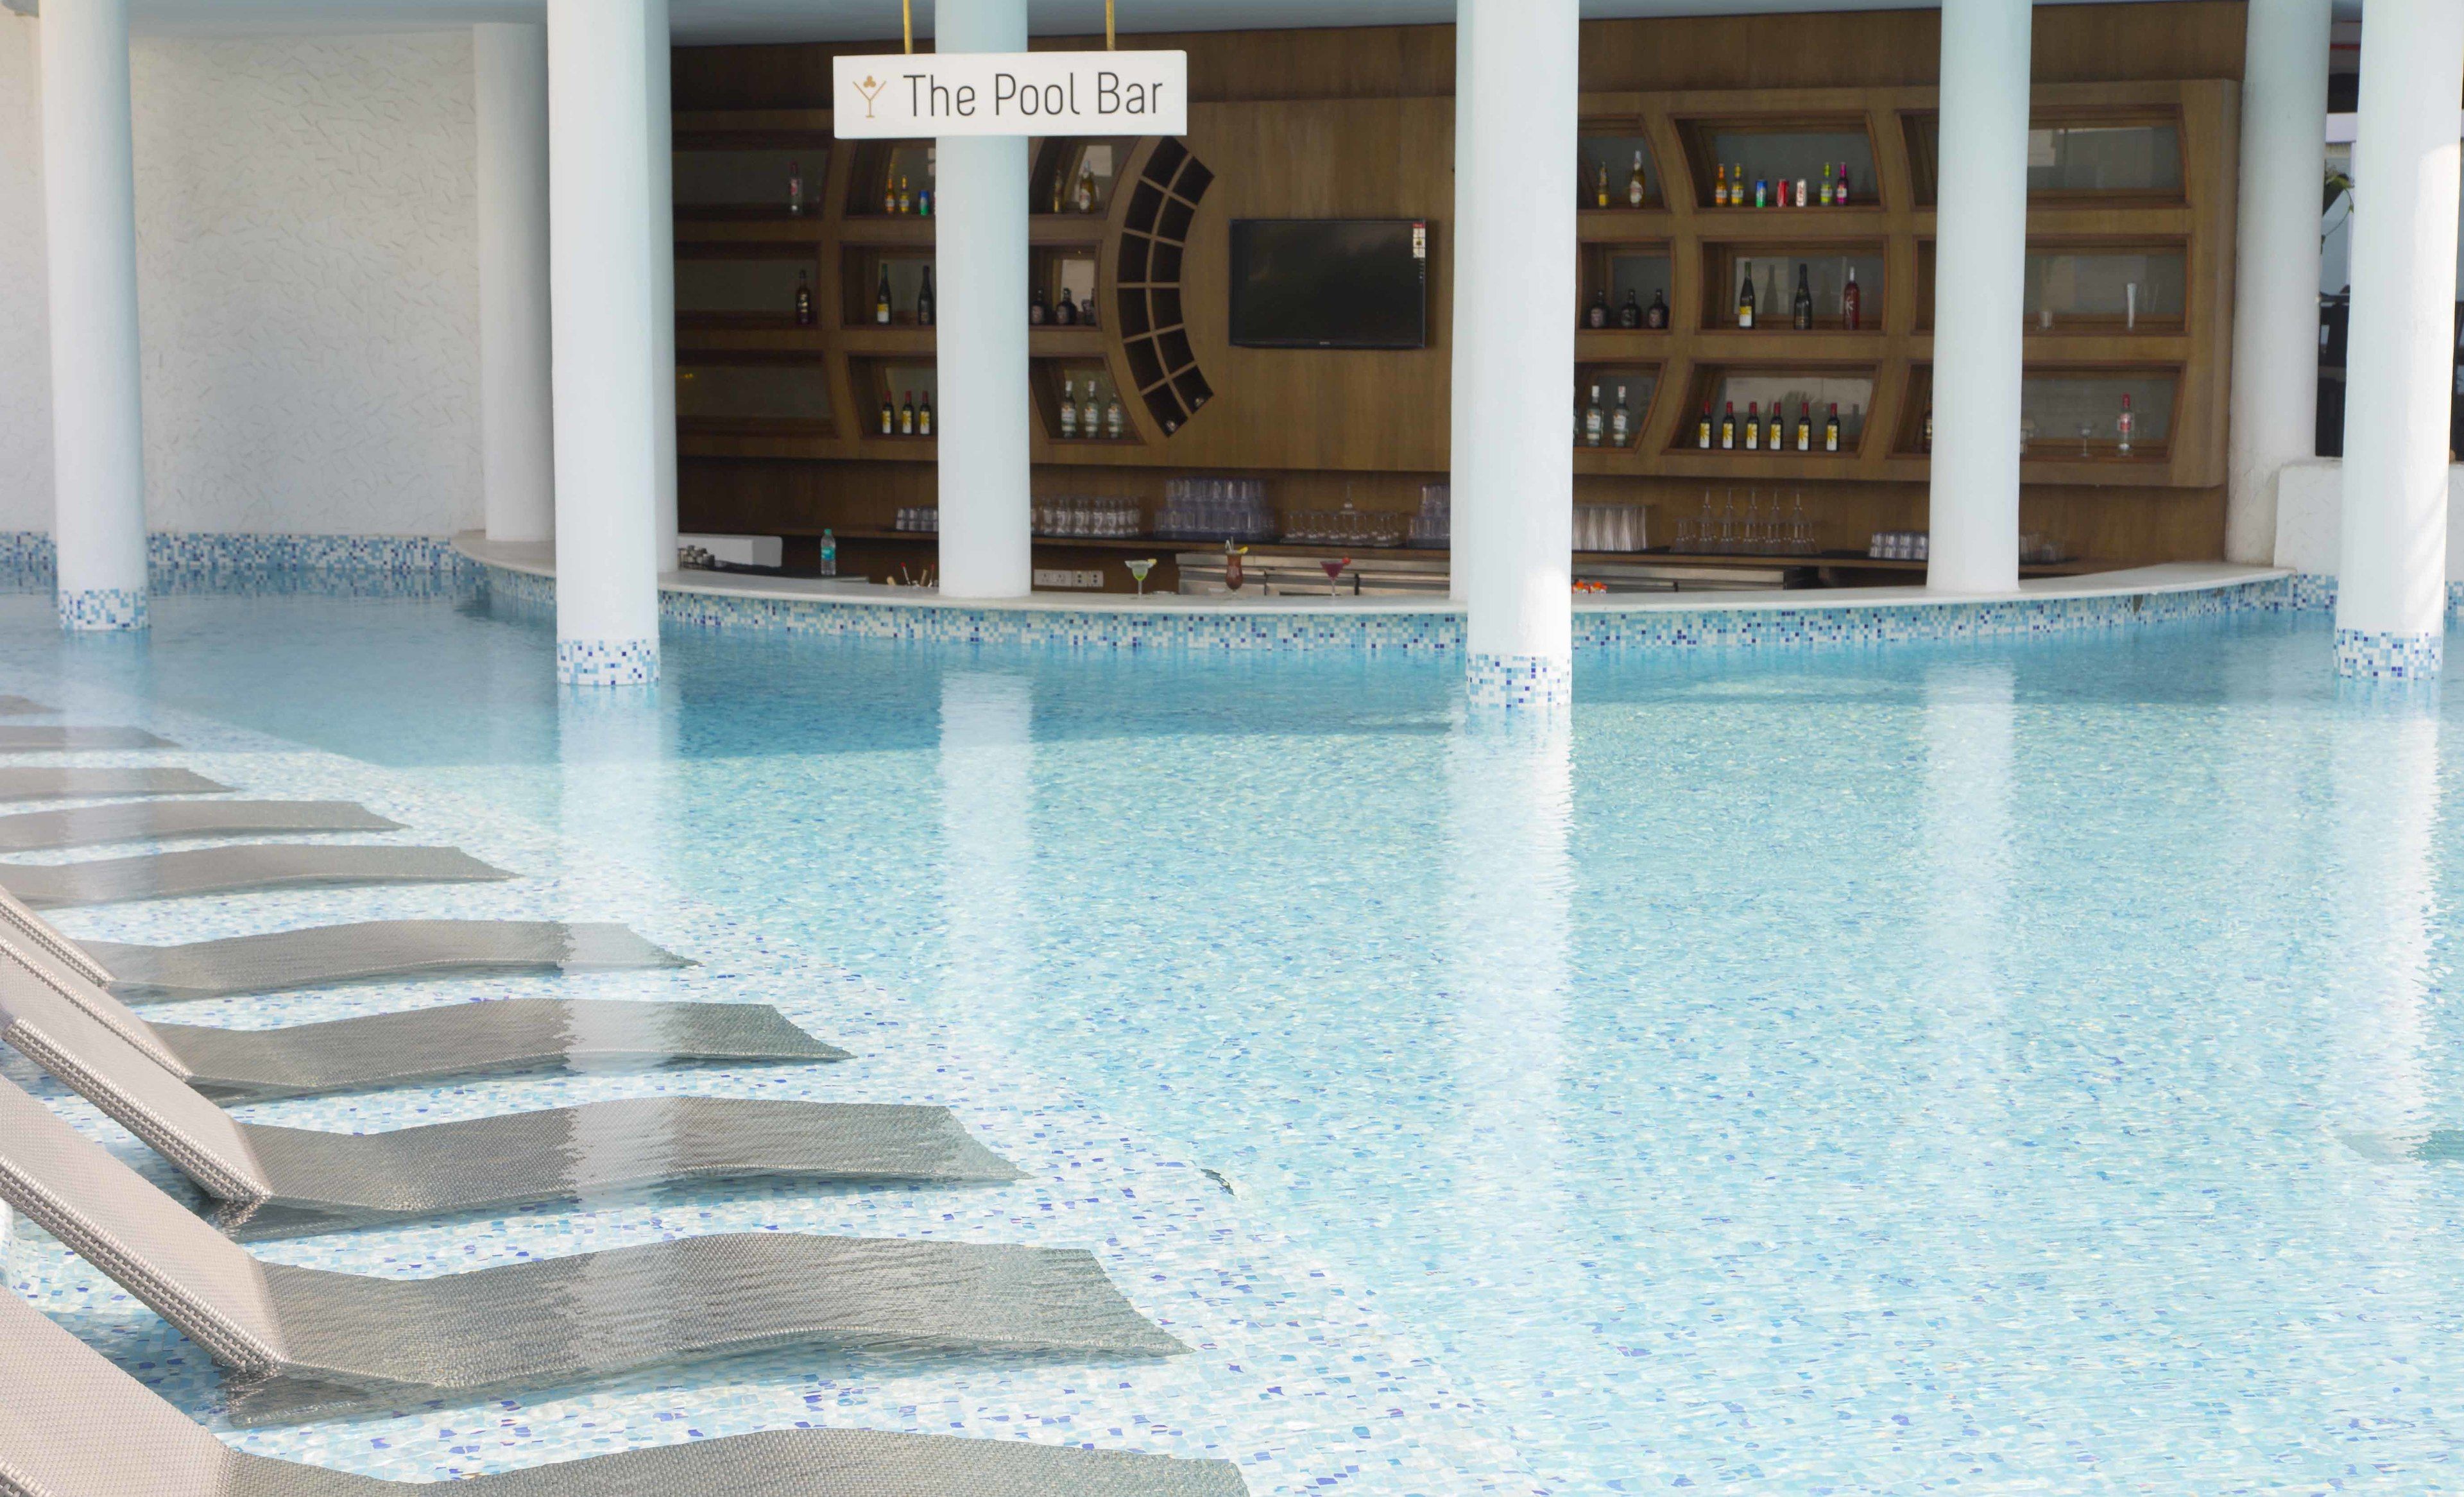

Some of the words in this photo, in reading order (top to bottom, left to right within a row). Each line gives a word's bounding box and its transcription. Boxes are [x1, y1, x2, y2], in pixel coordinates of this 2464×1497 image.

[903, 74, 975, 117] The
[995, 72, 1081, 116] Pool
[1097, 71, 1163, 114] Bar
